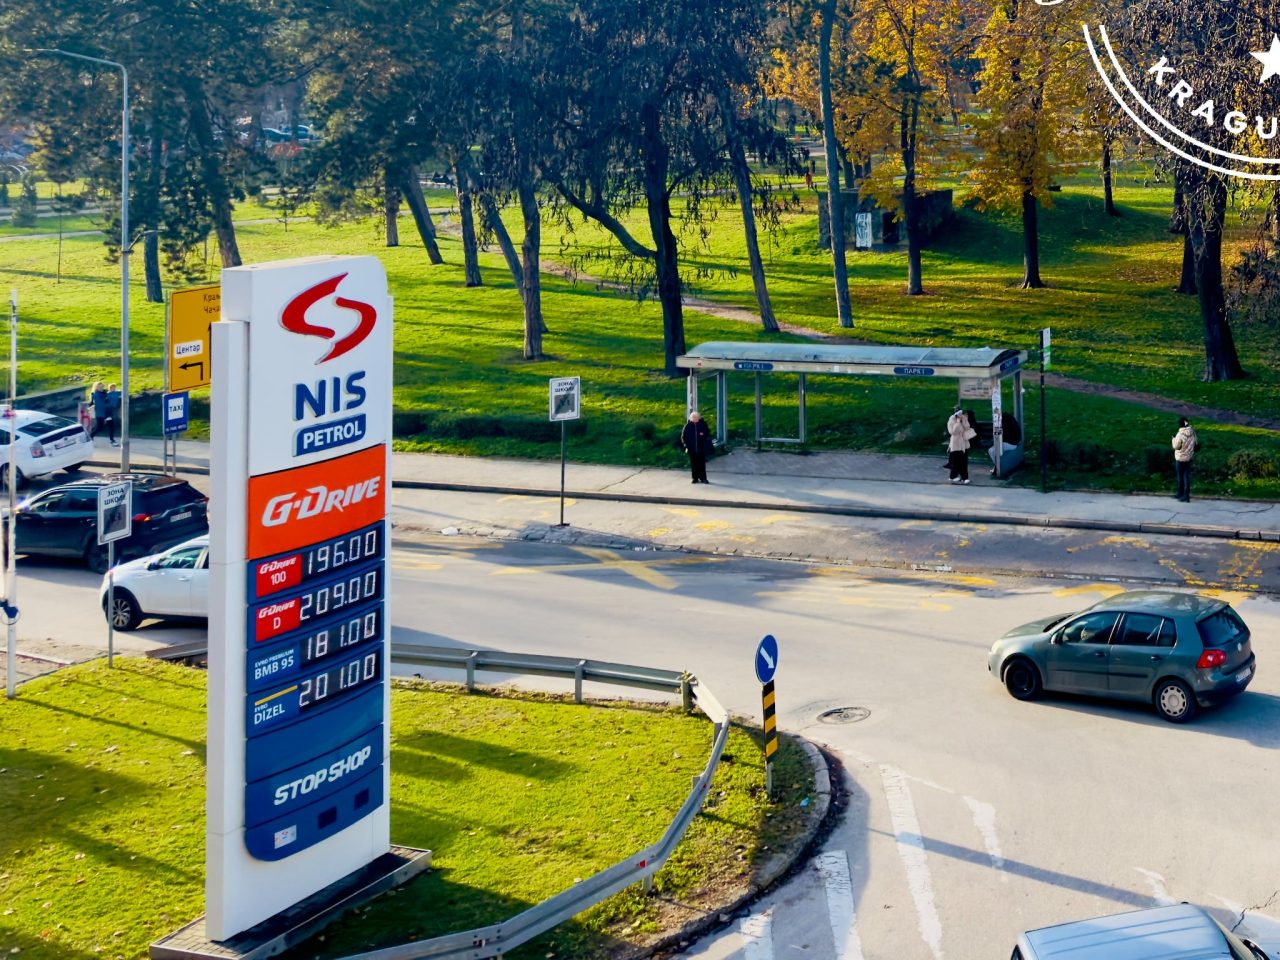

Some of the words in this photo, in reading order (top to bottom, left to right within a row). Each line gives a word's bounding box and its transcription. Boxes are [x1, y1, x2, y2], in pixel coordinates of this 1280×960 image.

[176, 344, 201, 355] Центар
[293, 370, 367, 421] NIS
[303, 419, 362, 449] PETROL
[308, 530, 378, 575] 196.00
[271, 571, 286, 585] 100
[299, 571, 377, 620] 209.00
[273, 617, 281, 630] D
[307, 612, 377, 660] 181.00
[254, 658, 269, 668] EVRO
[269, 649, 295, 662] PREMIUM
[254, 661, 279, 680] BMB
[281, 655, 294, 670] 95
[299, 653, 377, 707] 201.00
[254, 704, 286, 725] DIZEL
[273, 772, 327, 806] STOP
[328, 745, 372, 786] SHOP
